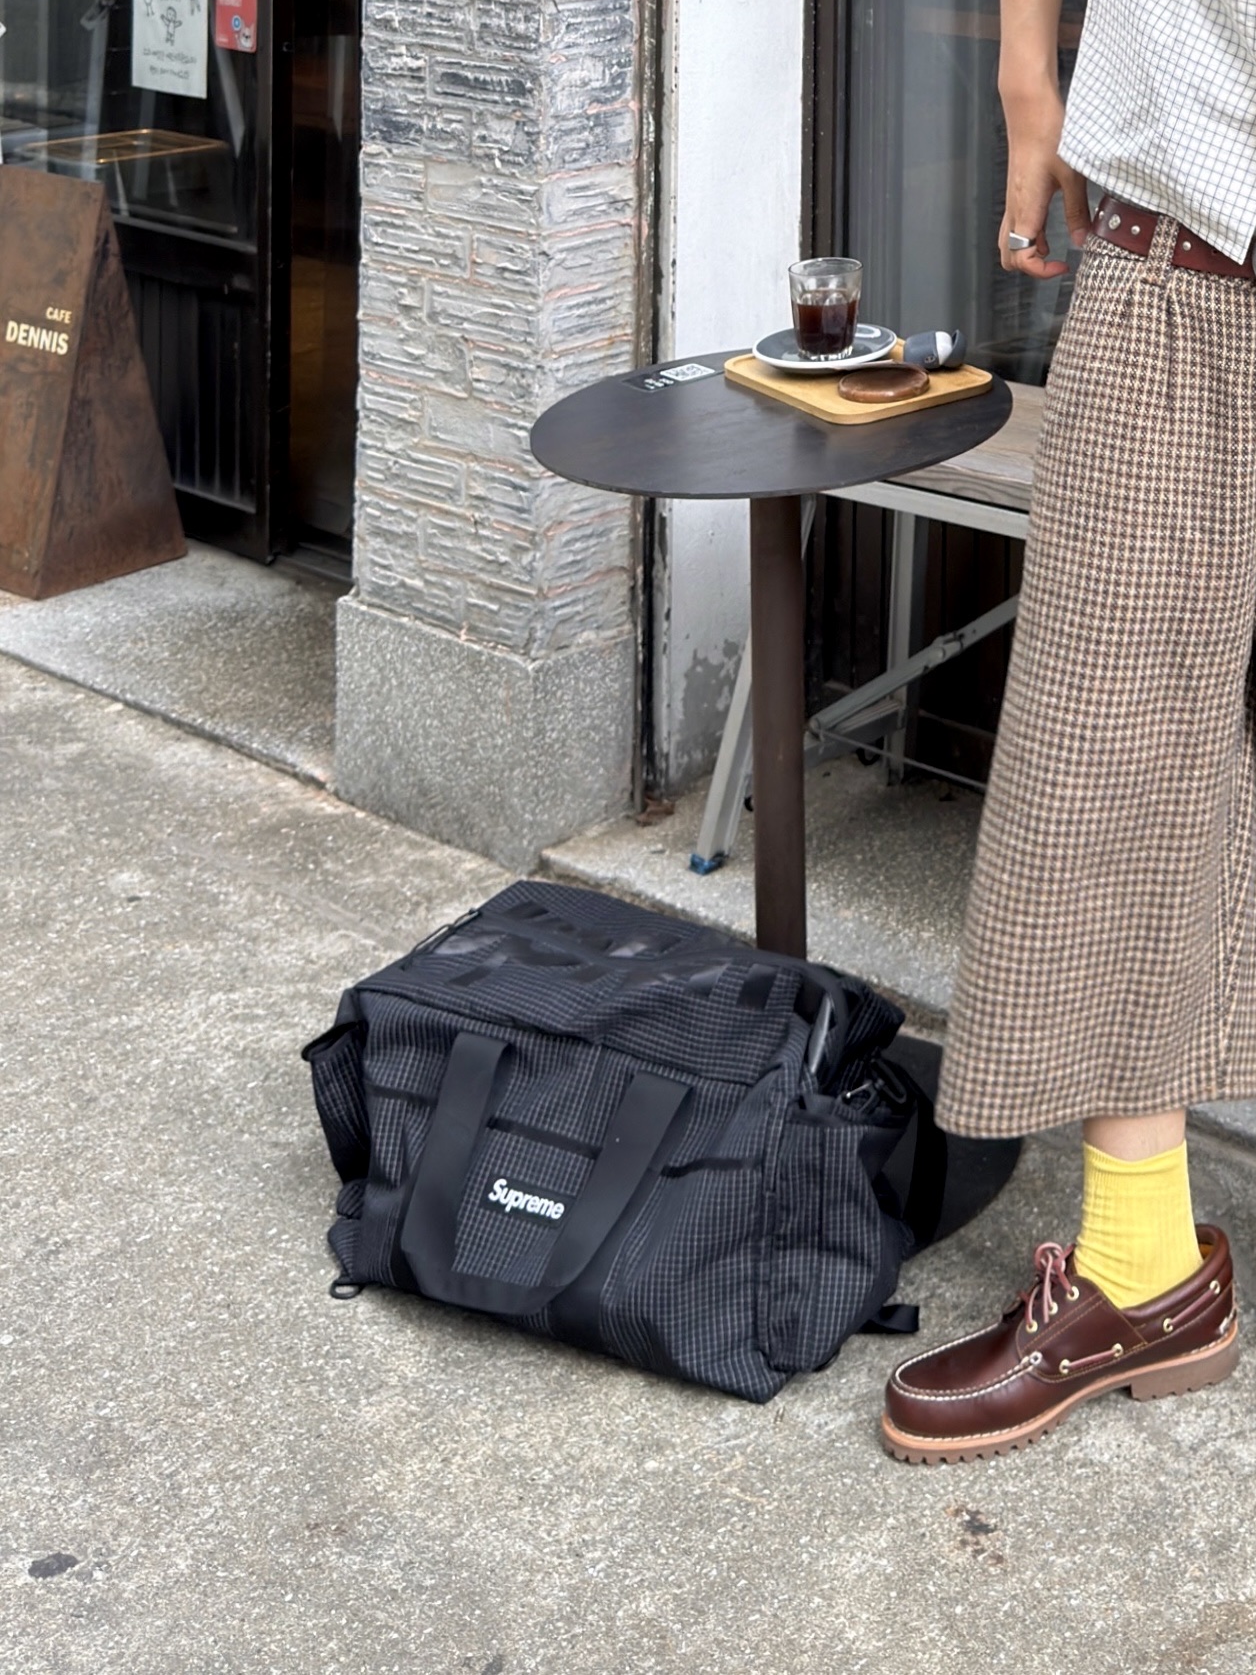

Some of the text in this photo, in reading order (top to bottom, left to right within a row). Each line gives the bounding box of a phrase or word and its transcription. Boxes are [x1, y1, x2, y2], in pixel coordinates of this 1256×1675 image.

[46, 307, 72, 324] CAFE
[5, 320, 69, 355] DENNIS
[488, 1178, 565, 1219] Supreme
